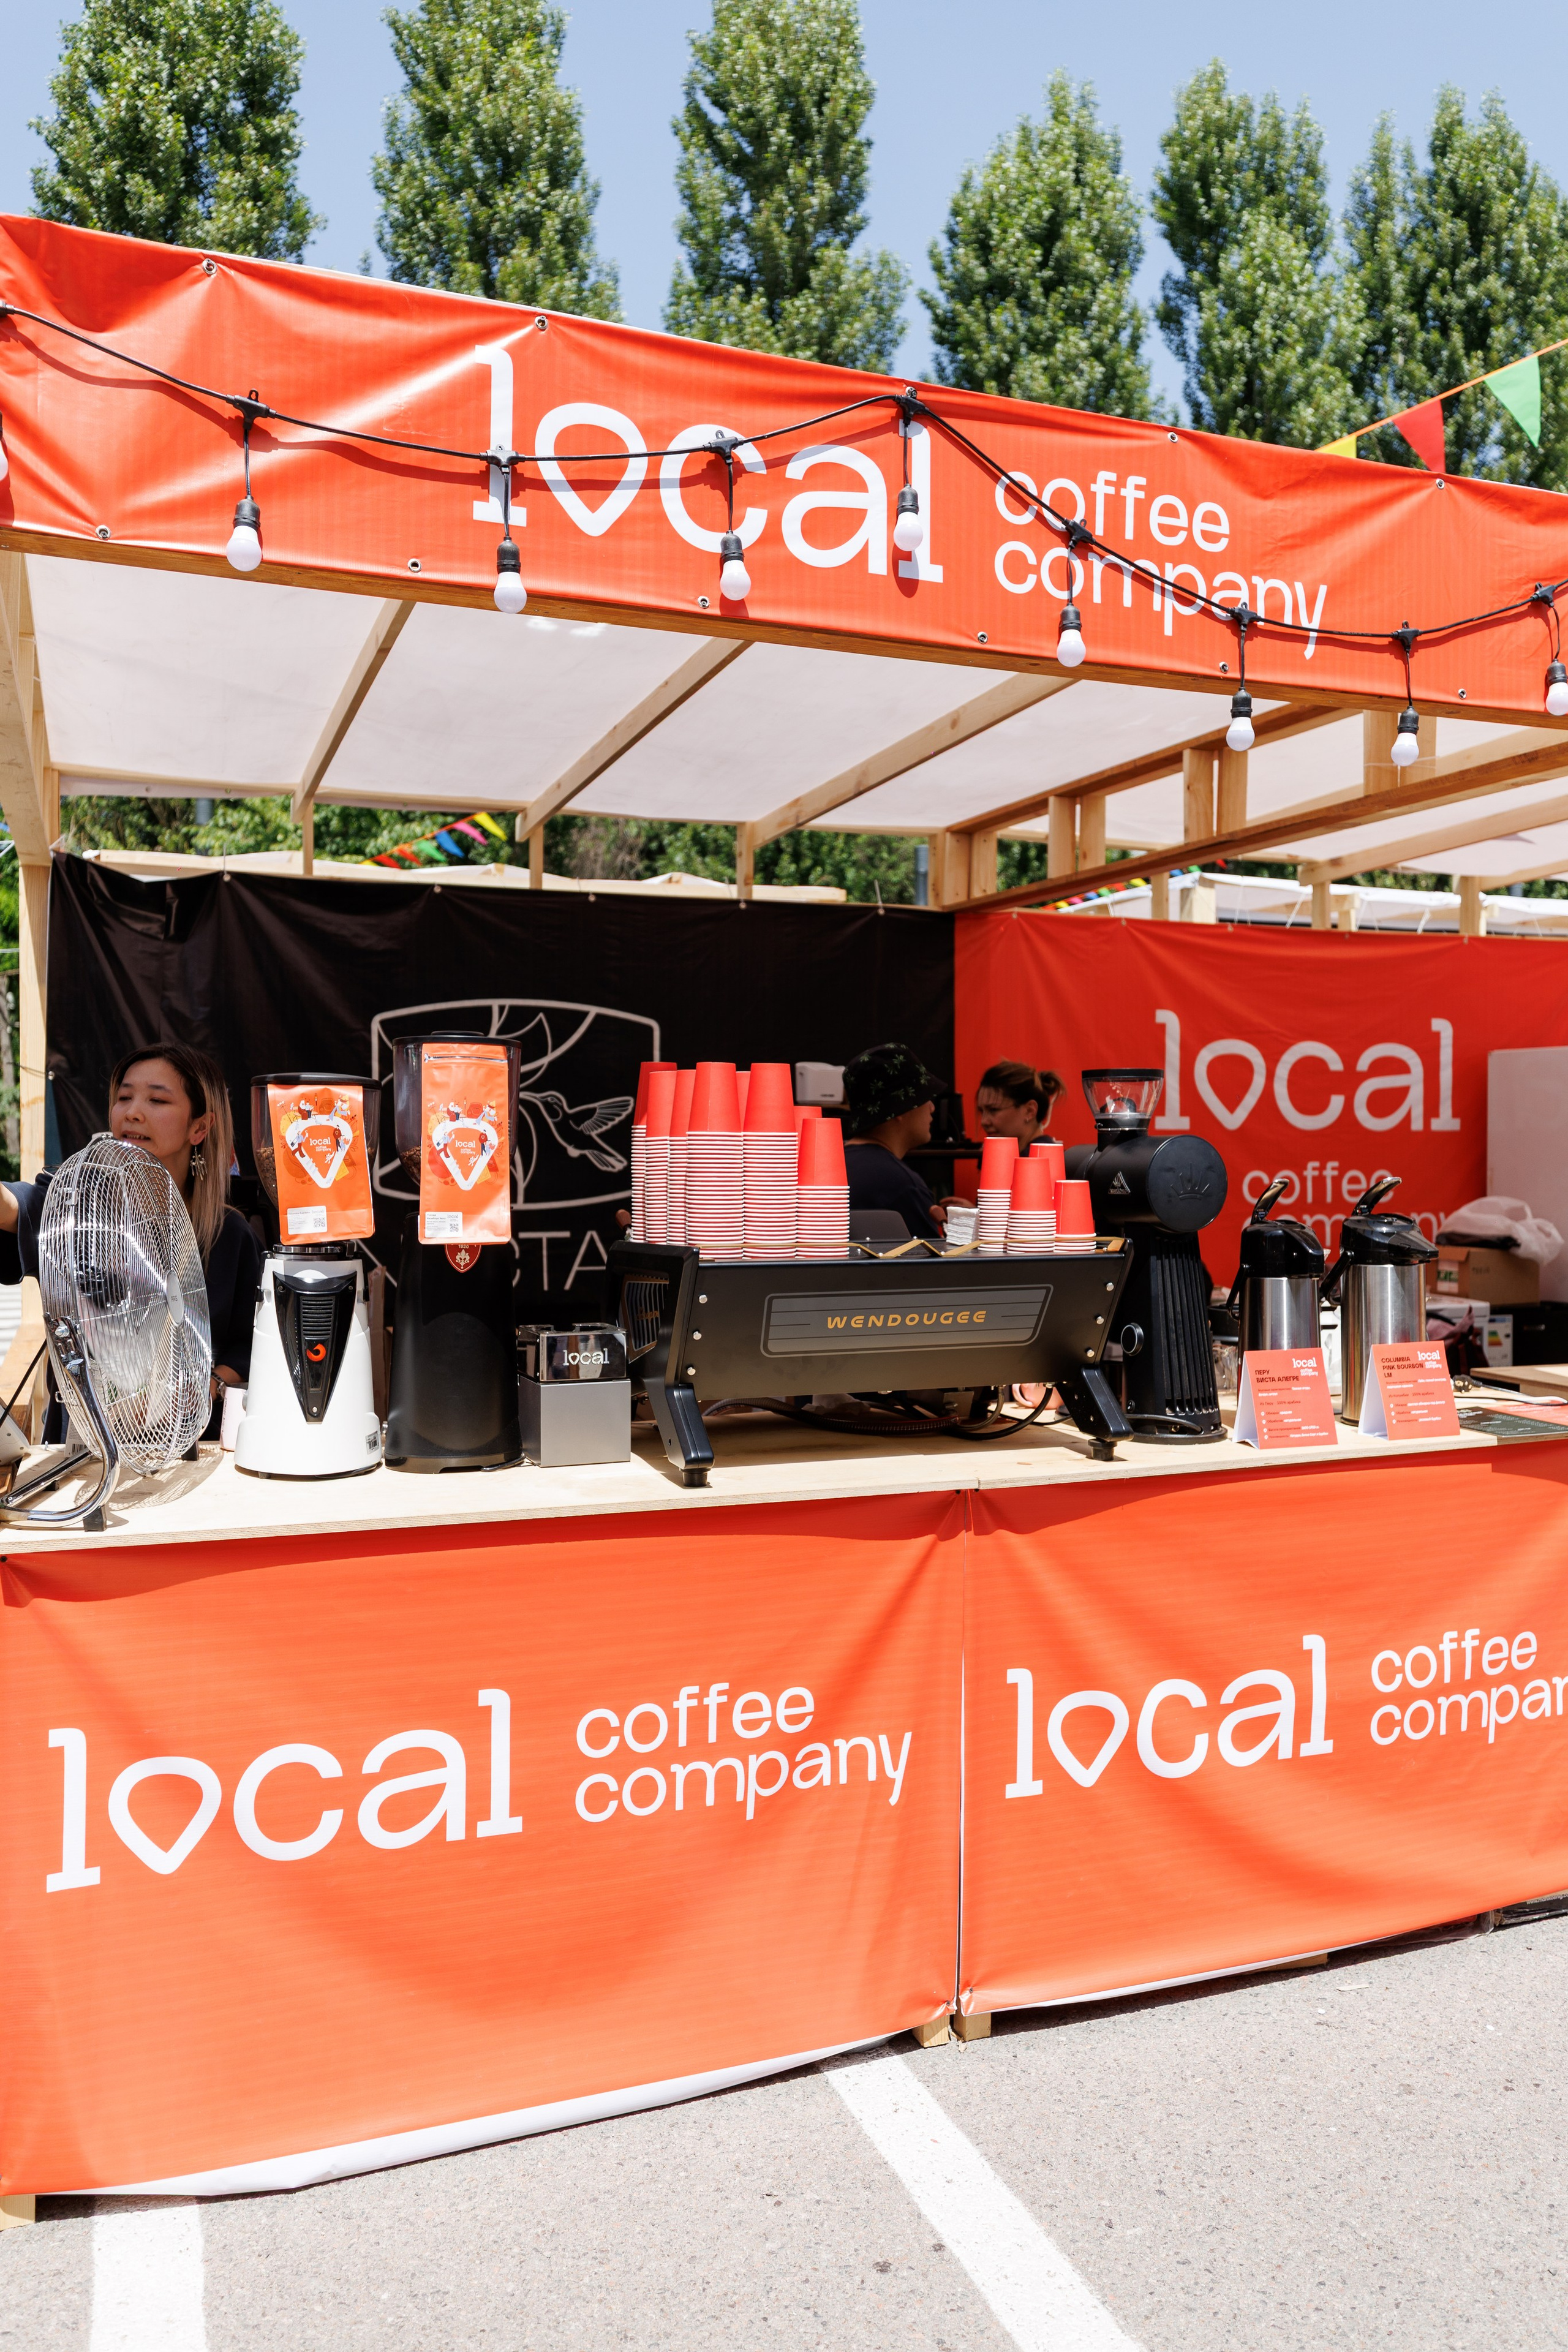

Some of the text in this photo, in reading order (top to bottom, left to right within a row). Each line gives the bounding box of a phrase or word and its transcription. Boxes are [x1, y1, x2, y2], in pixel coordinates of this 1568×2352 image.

[473, 345, 944, 583] local
[995, 470, 1230, 552] coffee
[994, 541, 1327, 660] company
[1155, 1009, 1461, 1131] local
[309, 1137, 331, 1146] local
[562, 1348, 610, 1366] local
[827, 1310, 987, 1329] WENDOUGEE
[1417, 1350, 1441, 1361] local
[1292, 1357, 1317, 1368] local
[1371, 1628, 1537, 1693] coffee
[576, 1682, 815, 1758] coffee
[1005, 1634, 1333, 1800] local
[46, 1688, 522, 1893] local
[575, 1732, 912, 1823] company
